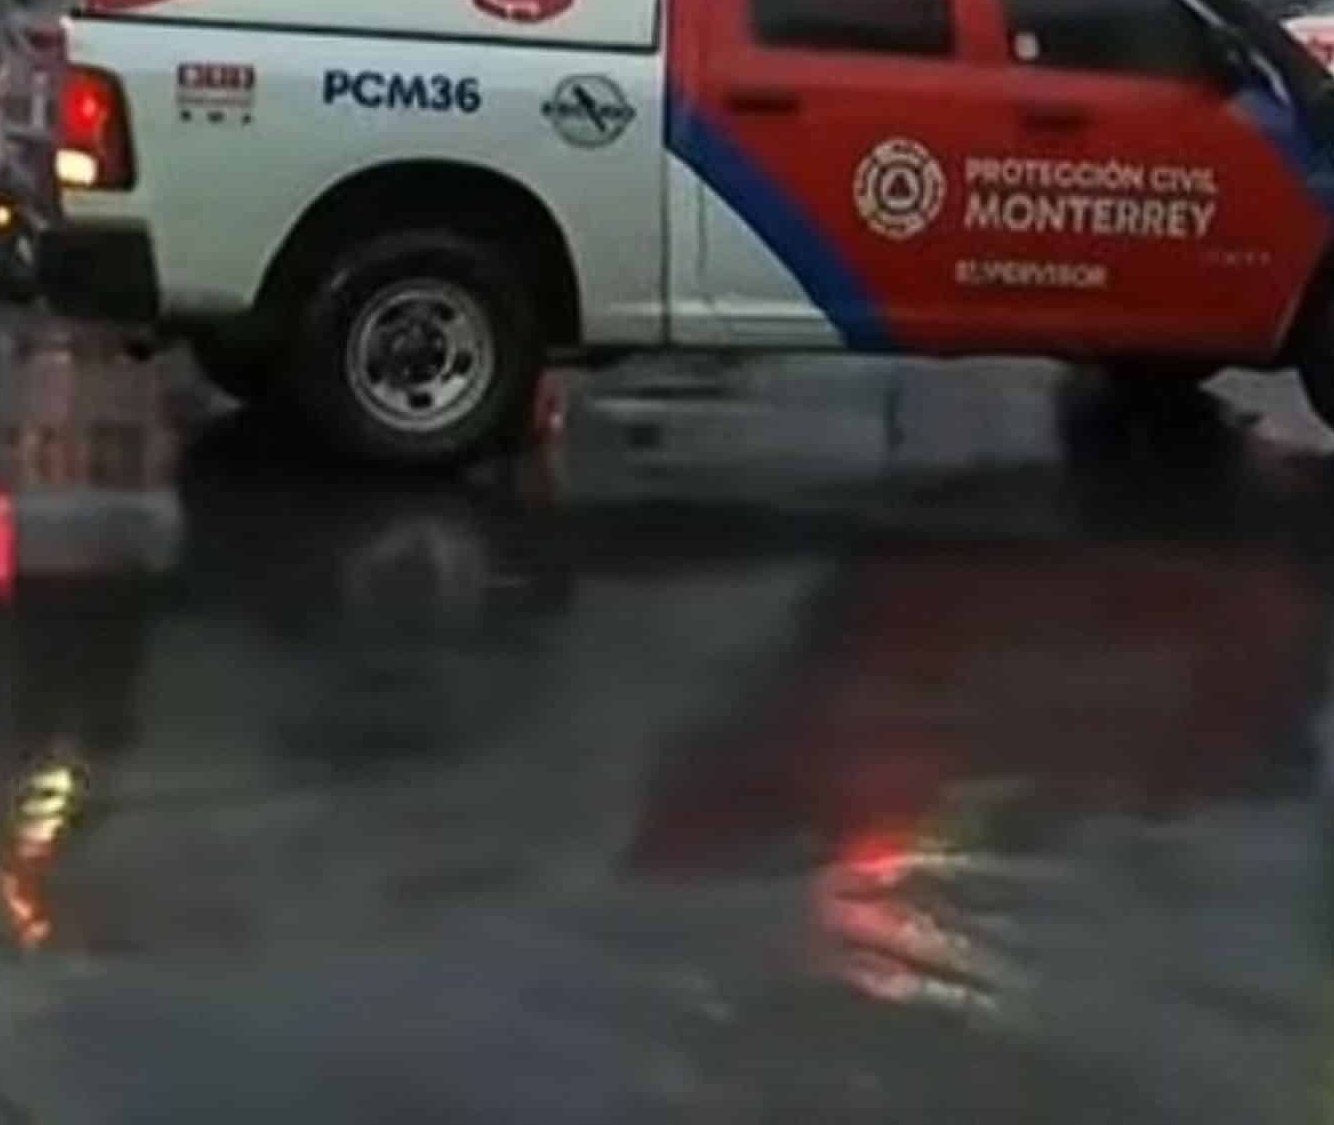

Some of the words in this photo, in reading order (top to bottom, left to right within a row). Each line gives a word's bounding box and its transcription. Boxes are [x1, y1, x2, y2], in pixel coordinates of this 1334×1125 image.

[322, 69, 483, 113] PCM36
[965, 157, 1146, 191] PROTECCIÓN
[1151, 166, 1218, 194] CIVIL
[964, 193, 1216, 237] MONTERREY
